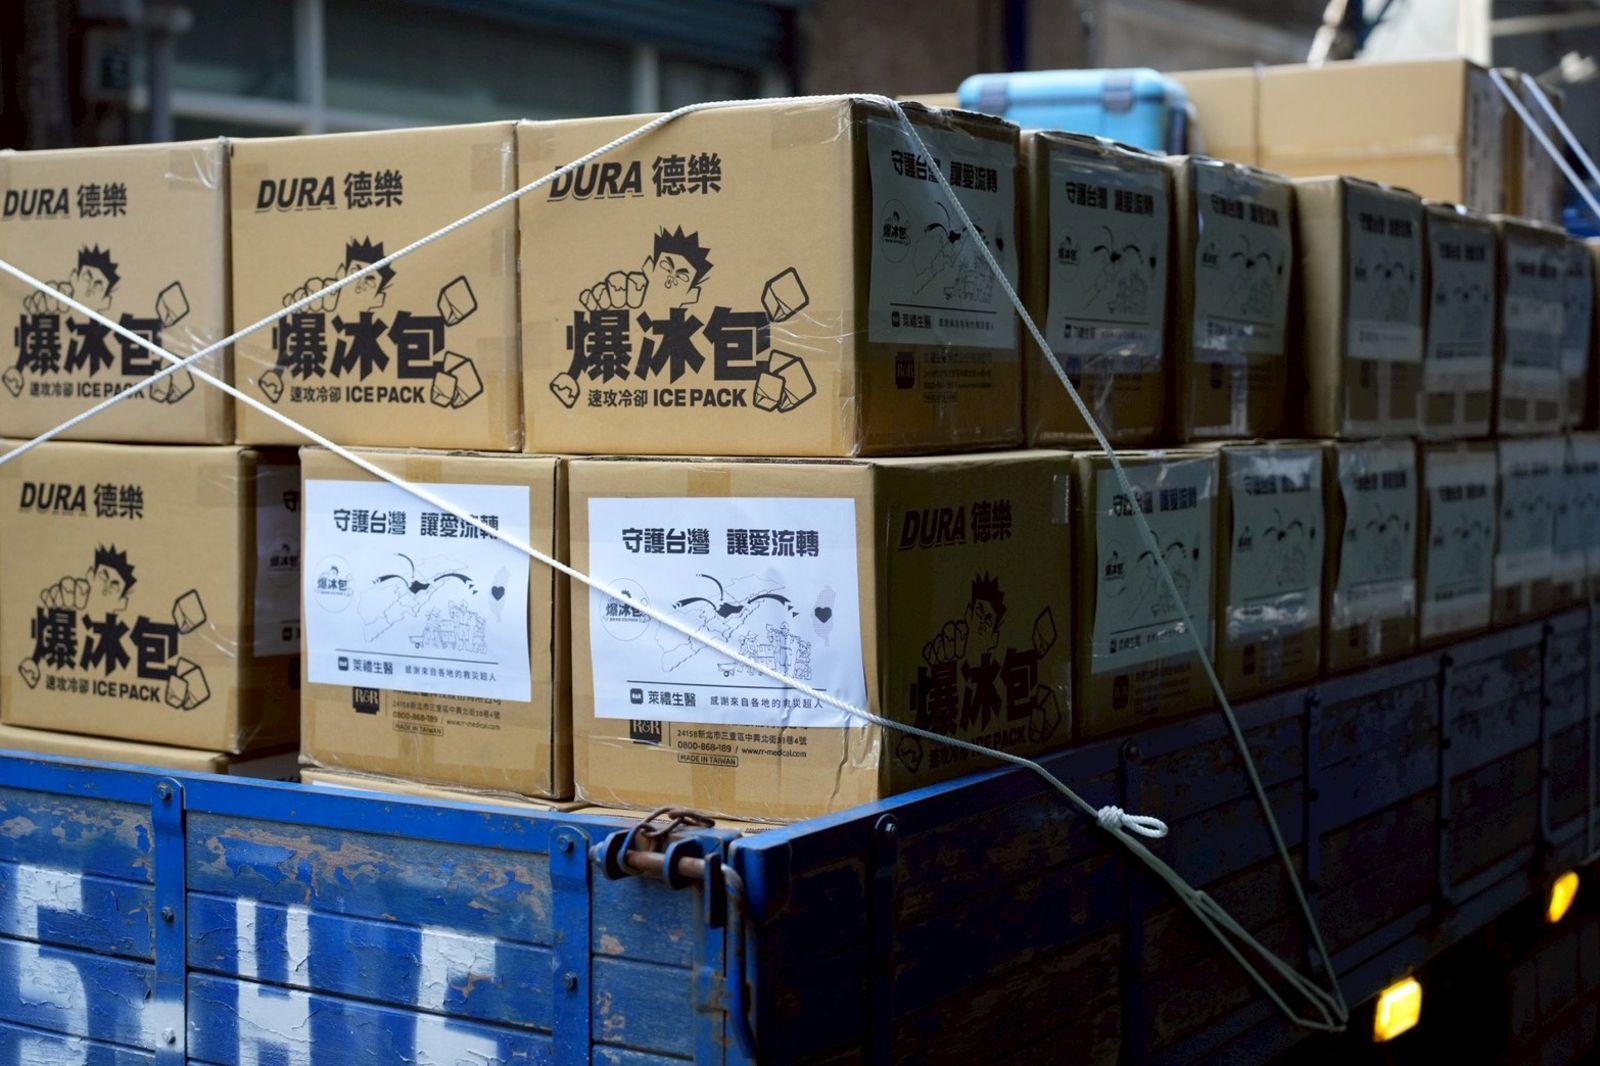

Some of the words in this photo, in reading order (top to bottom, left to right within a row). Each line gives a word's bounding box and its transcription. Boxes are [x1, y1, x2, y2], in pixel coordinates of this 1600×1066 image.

[255, 175, 337, 210] DURA
[343, 169, 404, 208] 德樂
[548, 159, 642, 199] DURA
[651, 152, 722, 196] 德樂
[2, 187, 70, 217] DURA
[76, 182, 128, 219] 德樂
[14, 312, 163, 378] 爆冰包
[271, 311, 447, 383] 爆冰包
[566, 306, 773, 385] 爆冰包
[77, 382, 103, 398] ICE
[290, 386, 341, 402] 速攻冷卻
[345, 386, 375, 403] ICE
[377, 386, 426, 403] PACK
[588, 389, 648, 408] 速攻冷卻
[653, 389, 686, 408] ICE
[689, 389, 747, 408] PACK
[18, 481, 88, 512] DURA
[93, 483, 145, 520] 德樂
[333, 508, 407, 536] 守護台灣
[898, 505, 967, 550] DURA
[971, 500, 1013, 543] 德樂
[621, 527, 711, 555] 守護台灣
[726, 528, 820, 558] 讓愛流轉
[31, 606, 180, 681] 爆冰包
[45, 675, 91, 695] 速攻冷卻
[92, 676, 117, 698] ICE
[119, 681, 162, 703] PACK
[354, 688, 379, 706] R&R
[647, 690, 697, 708] 萊禮生醫
[909, 648, 1041, 736] 爆冰包
[632, 720, 661, 735] R&R
[677, 740, 732, 754] 0800-868-189
[741, 746, 807, 759] www.rr-medical.com
[680, 753, 700, 763] MADE
[701, 755, 708, 764] IN
[709, 756, 736, 766] TAIWAN
